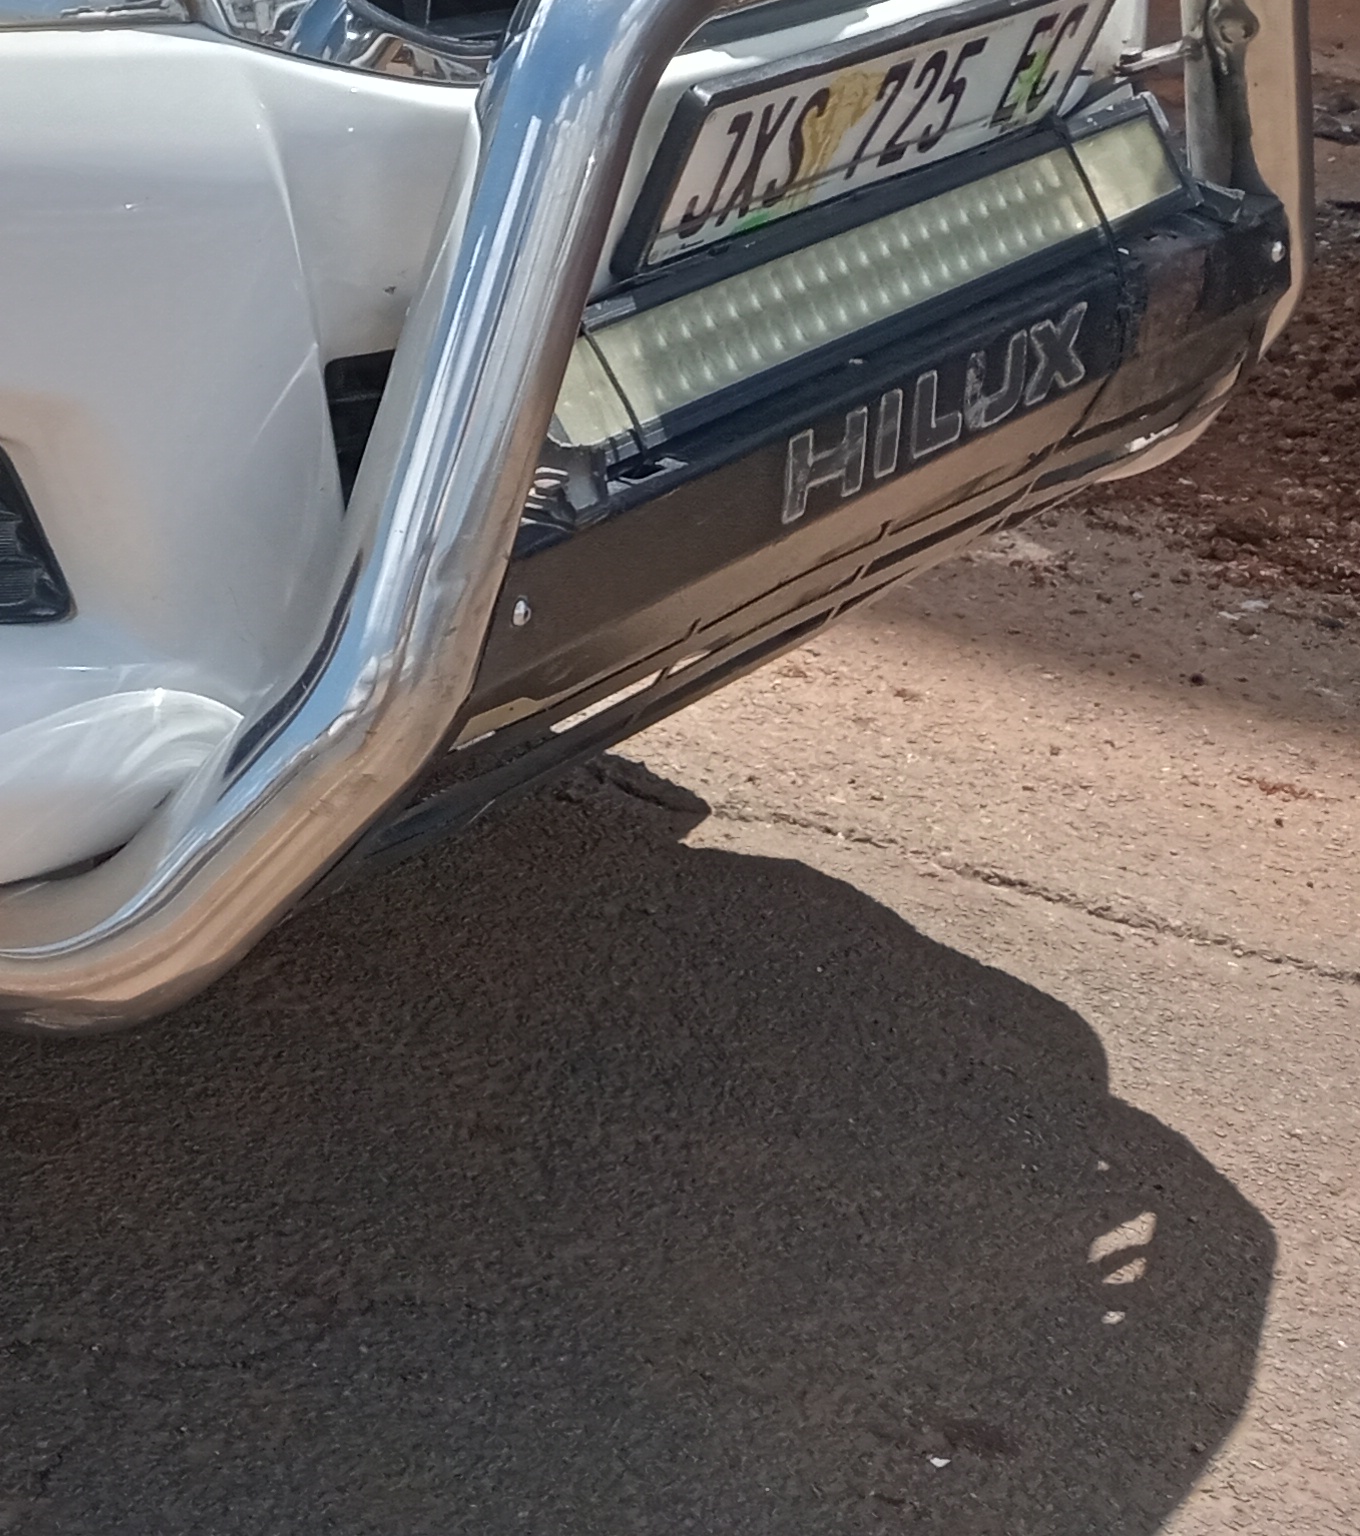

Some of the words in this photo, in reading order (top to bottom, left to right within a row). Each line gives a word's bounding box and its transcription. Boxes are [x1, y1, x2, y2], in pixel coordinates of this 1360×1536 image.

[677, 86, 830, 240] JXS
[843, 36, 990, 181] 725
[988, 2, 1089, 130] EC
[781, 301, 1088, 525] HILUX
